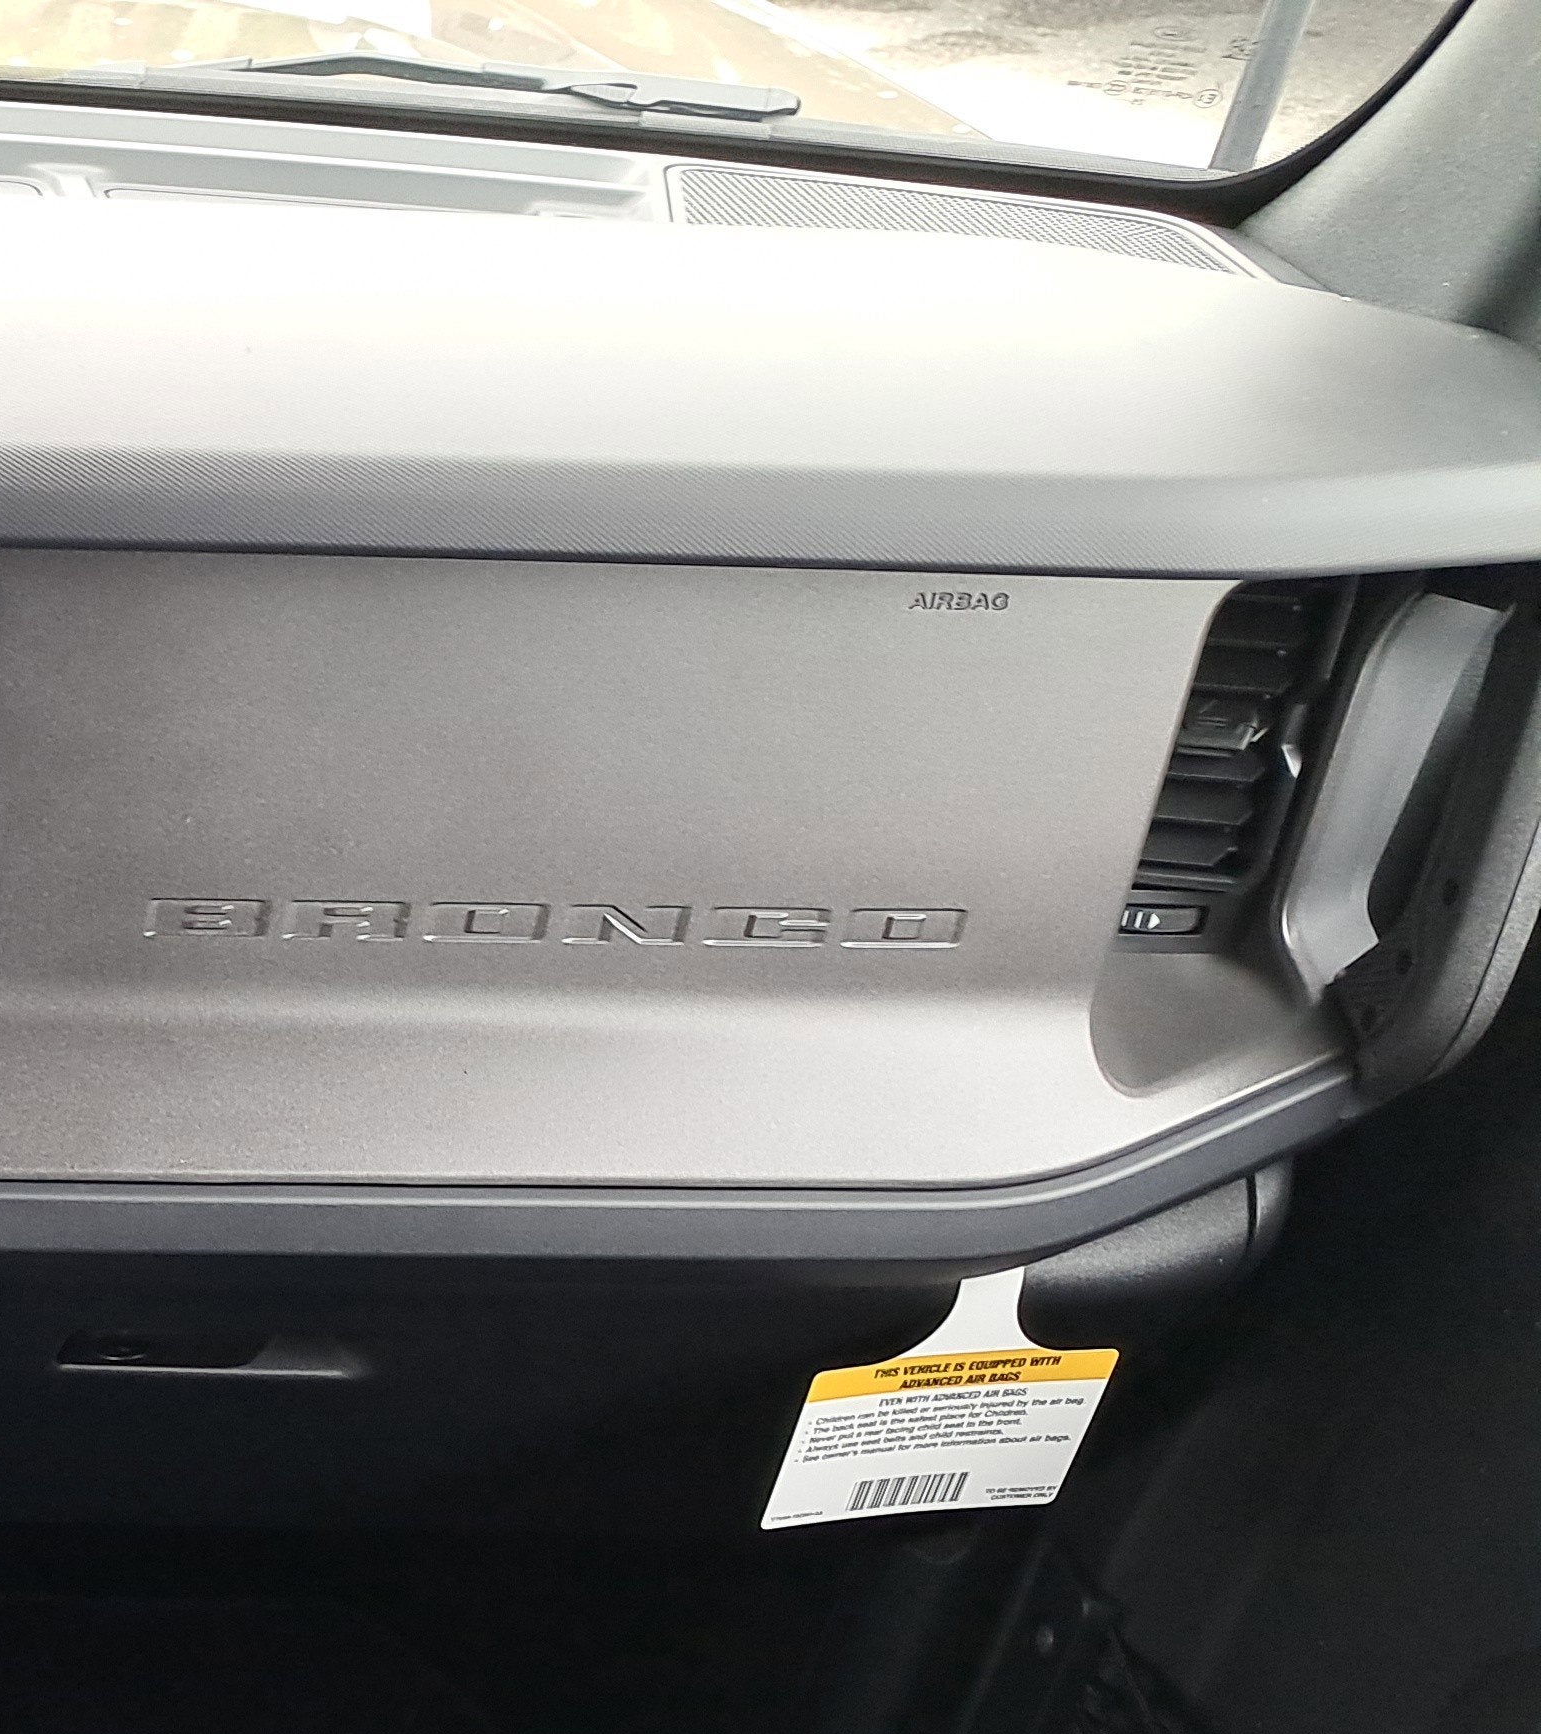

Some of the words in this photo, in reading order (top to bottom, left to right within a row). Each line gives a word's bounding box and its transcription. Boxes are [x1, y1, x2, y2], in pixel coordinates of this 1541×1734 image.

[908, 592, 1010, 611] AIRBAG
[143, 896, 969, 949] BRONCO
[874, 1366, 900, 1379] THIS
[903, 1363, 952, 1376] VEHICLE
[953, 1361, 965, 1372] IS
[968, 1358, 1026, 1371] EQUIPPED
[1030, 1356, 1062, 1367] WITH
[900, 1375, 963, 1389] ADVANCED
[964, 1373, 986, 1384] AIR
[988, 1371, 1021, 1382] BAGS
[879, 1398, 903, 1408] EVEN
[906, 1395, 930, 1404] WITH
[931, 1390, 981, 1402] ADVANCED
[983, 1390, 1000, 1398] AIR
[1002, 1388, 1029, 1397] BAGS
[815, 1414, 856, 1425] Children
[891, 1407, 919, 1416] killed
[979, 1400, 1015, 1409] injured
[1032, 1398, 1048, 1406] the
[832, 1424, 854, 1433] back
[857, 1421, 877, 1429] seat
[939, 1413, 966, 1422] place
[809, 1436, 835, 1444] Never
[838, 1433, 854, 1441] put
[917, 1423, 942, 1432] child
